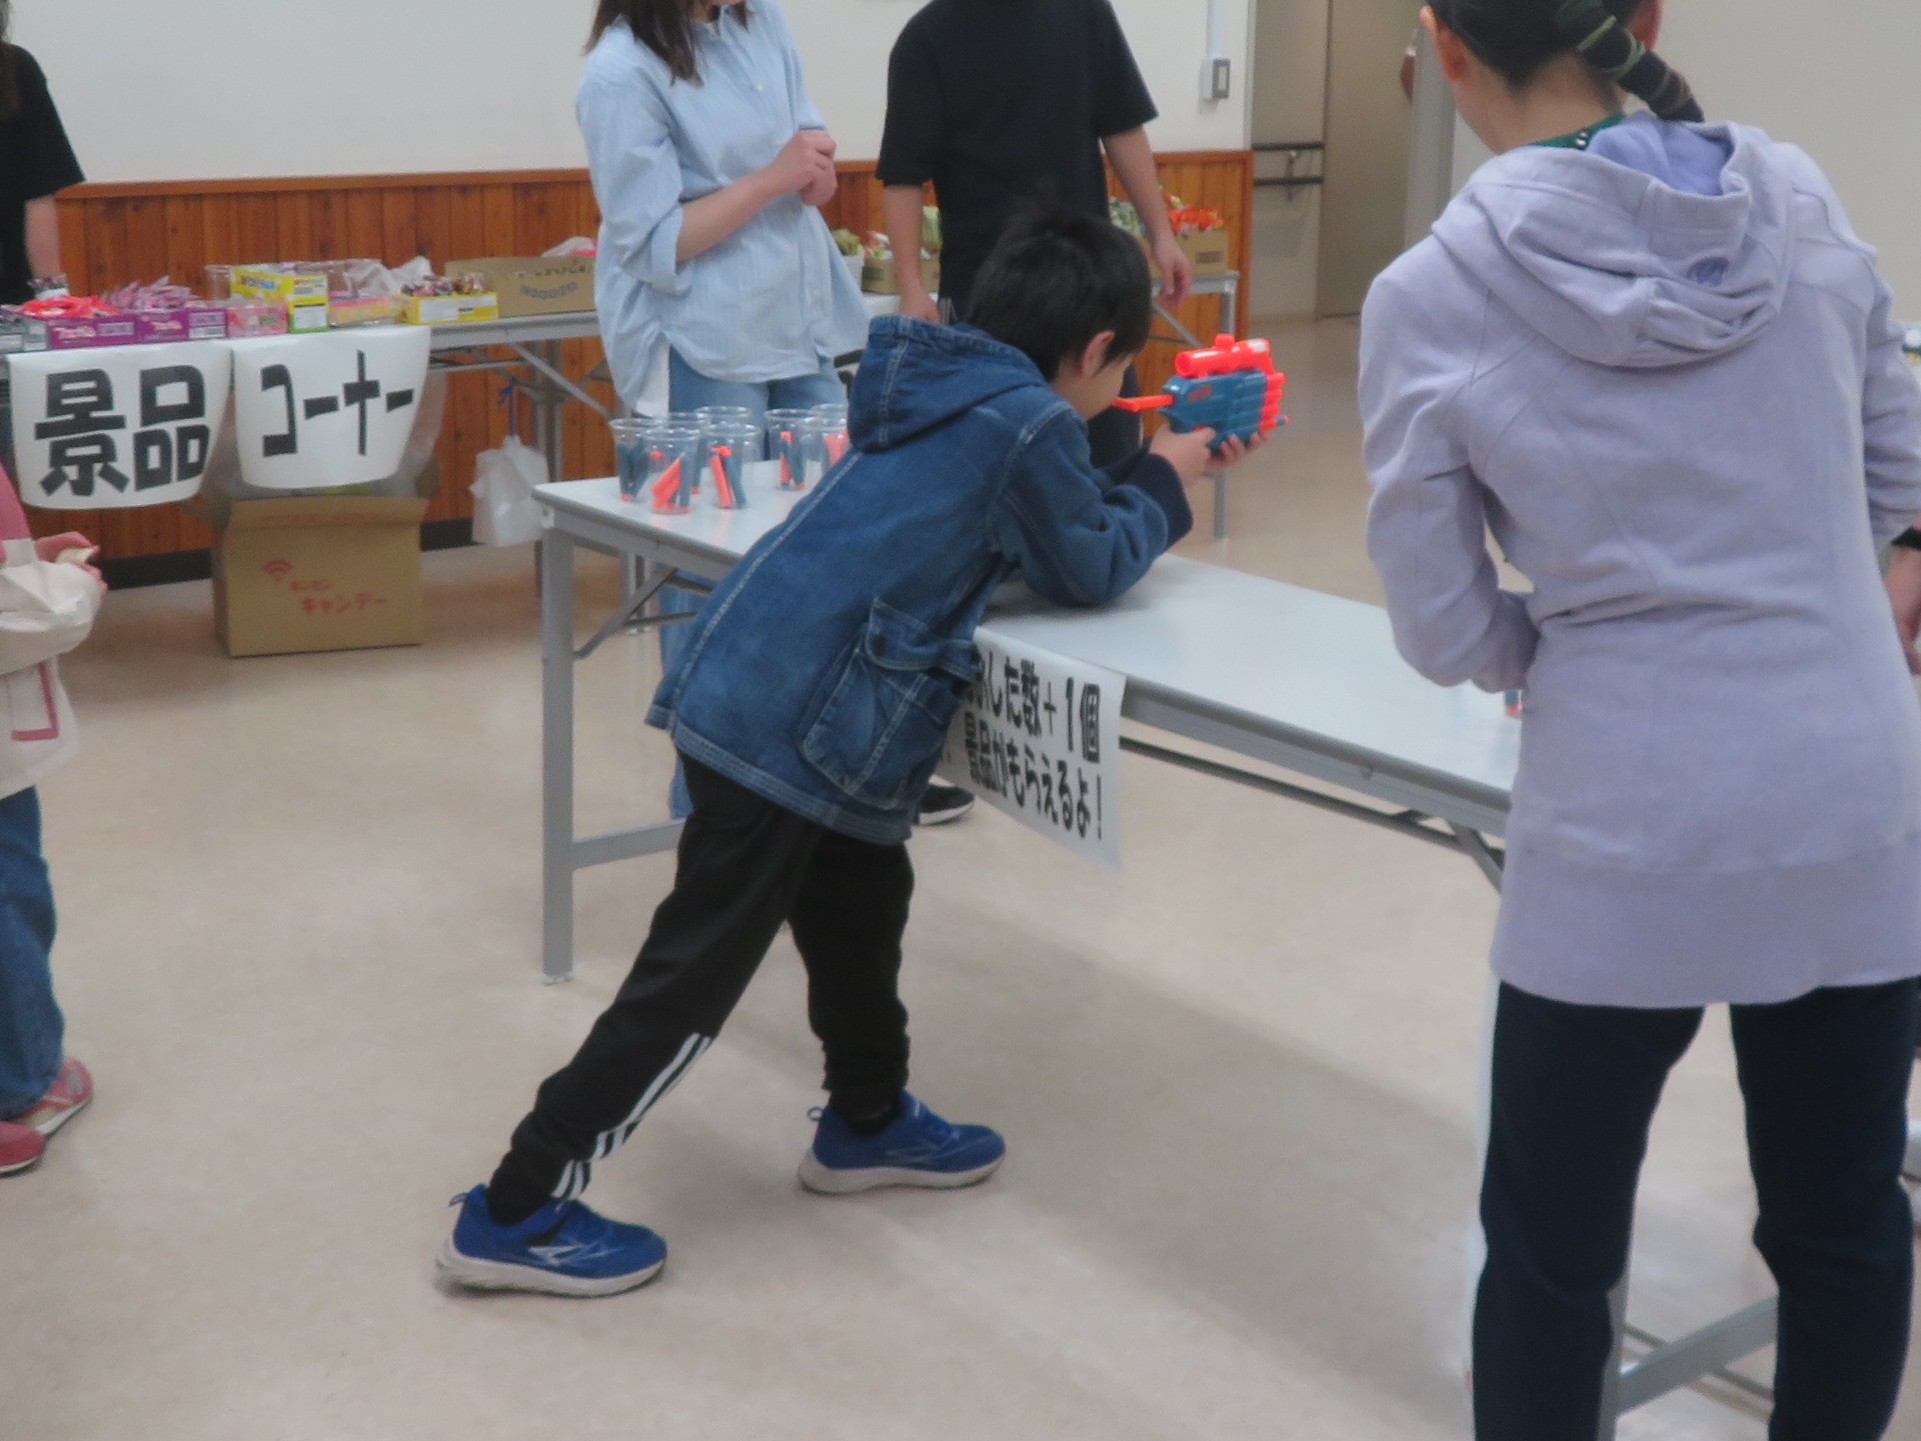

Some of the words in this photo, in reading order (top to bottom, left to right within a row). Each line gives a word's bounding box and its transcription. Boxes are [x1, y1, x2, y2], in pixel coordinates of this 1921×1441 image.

[35, 364, 210, 497] 景品
[260, 349, 415, 457] コーナー
